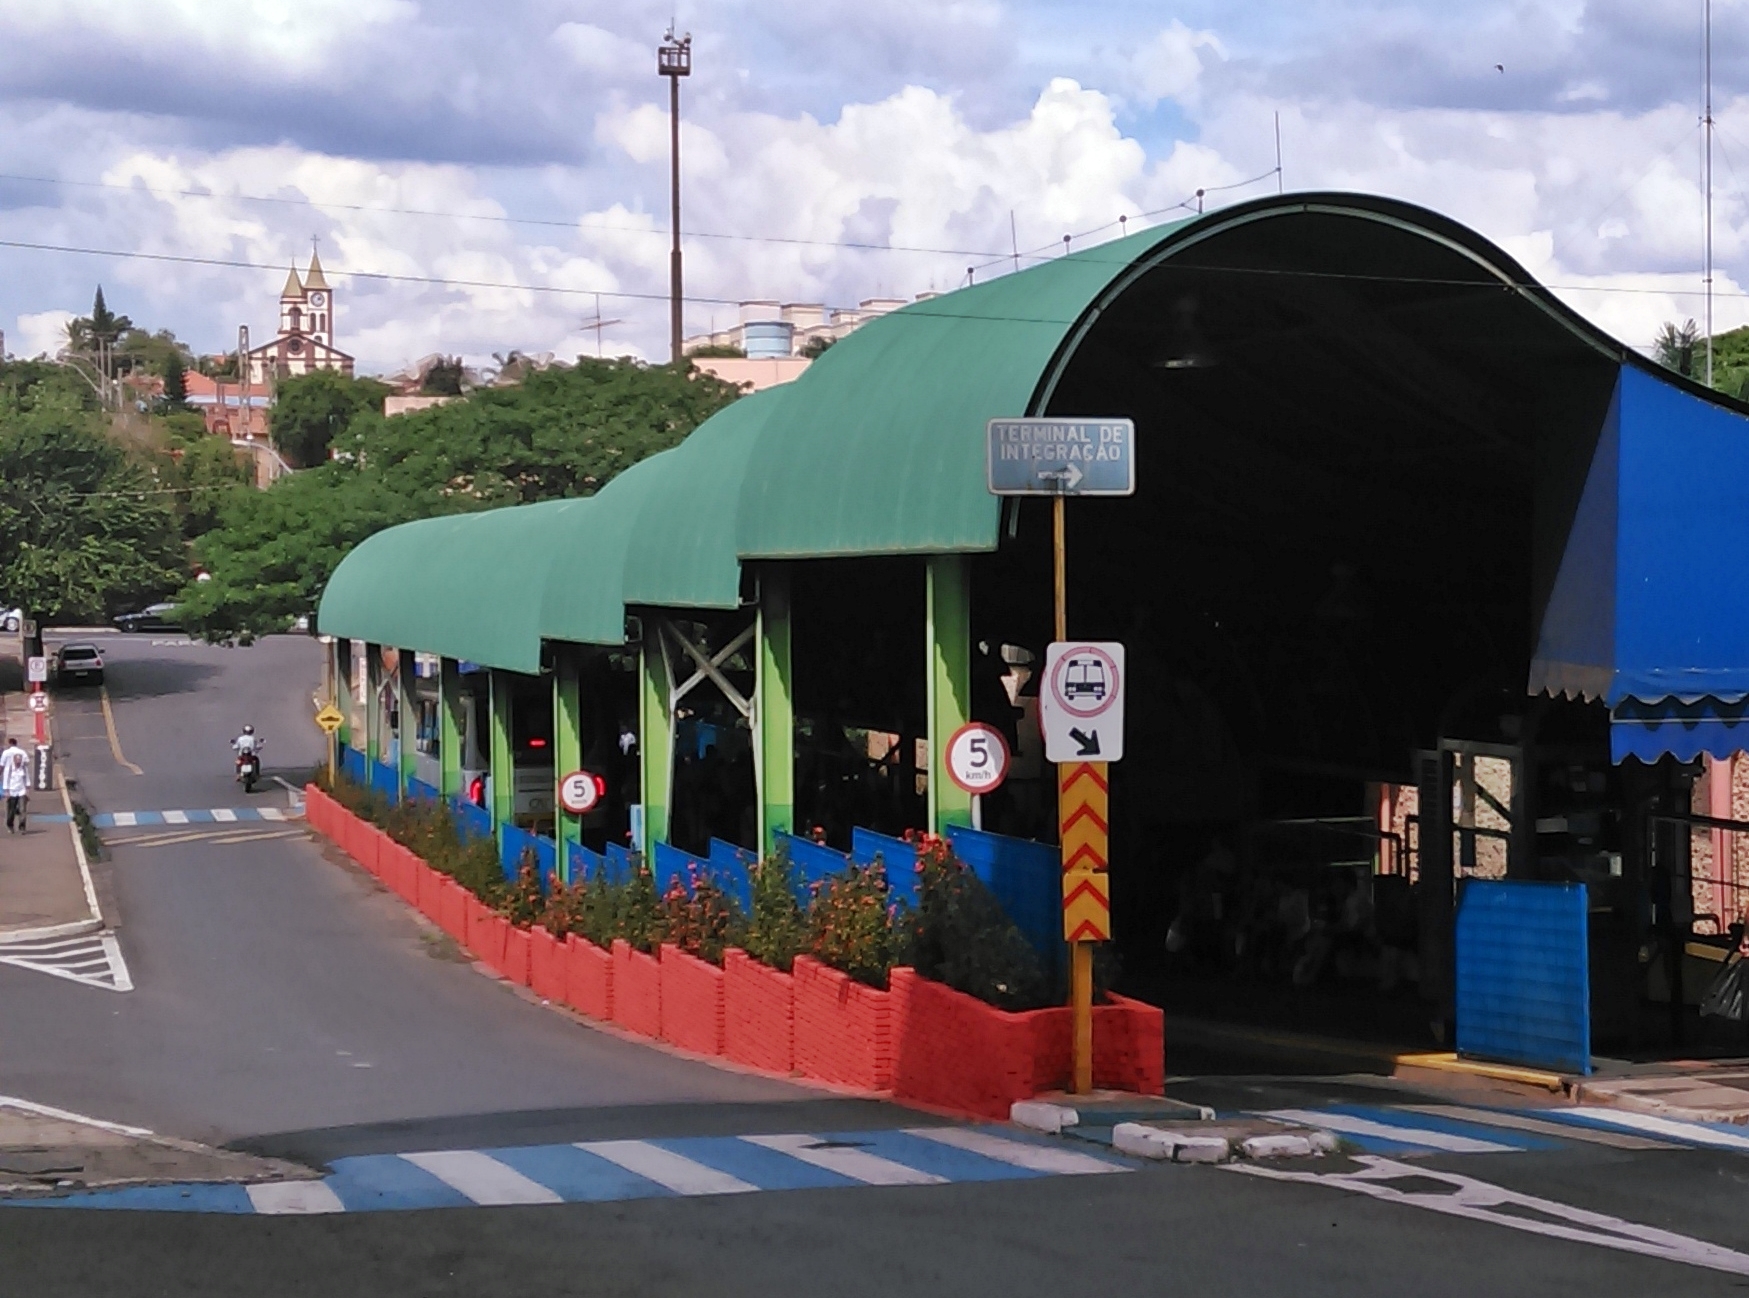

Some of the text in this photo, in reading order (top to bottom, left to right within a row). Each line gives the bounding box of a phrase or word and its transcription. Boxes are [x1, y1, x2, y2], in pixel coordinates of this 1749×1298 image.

[997, 425, 1123, 443] TERMINAL DE
[970, 738, 988, 768] 5
[965, 770, 991, 780] km/h
[573, 780, 586, 798] 5
